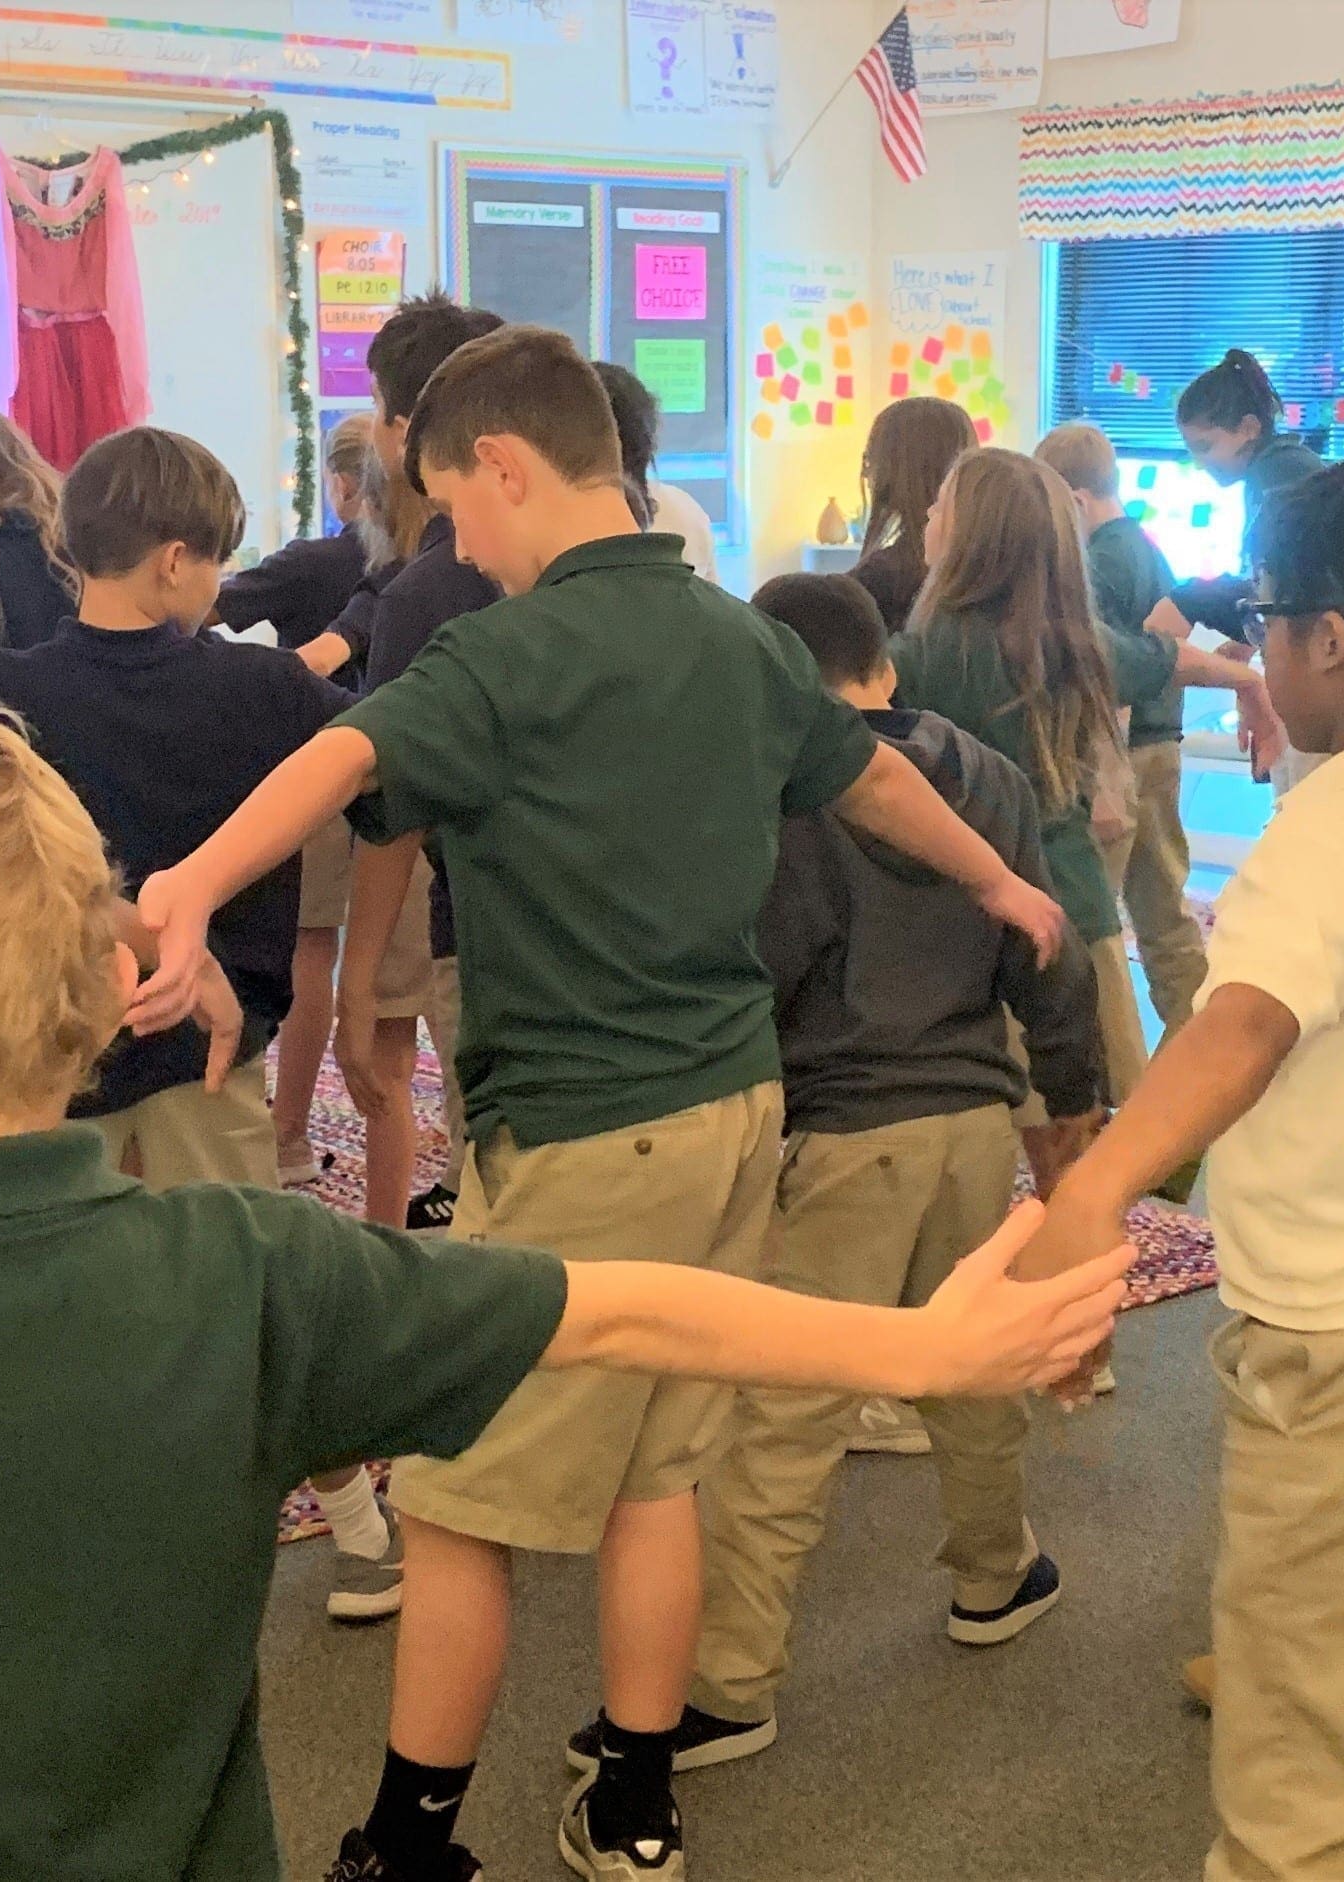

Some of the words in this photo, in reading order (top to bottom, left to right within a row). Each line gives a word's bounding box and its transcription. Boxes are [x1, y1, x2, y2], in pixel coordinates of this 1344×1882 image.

[486, 205, 535, 222] Memory
[540, 208, 572, 221] Verse
[653, 255, 691, 275] FREE
[641, 288, 703, 308] CHOICE
